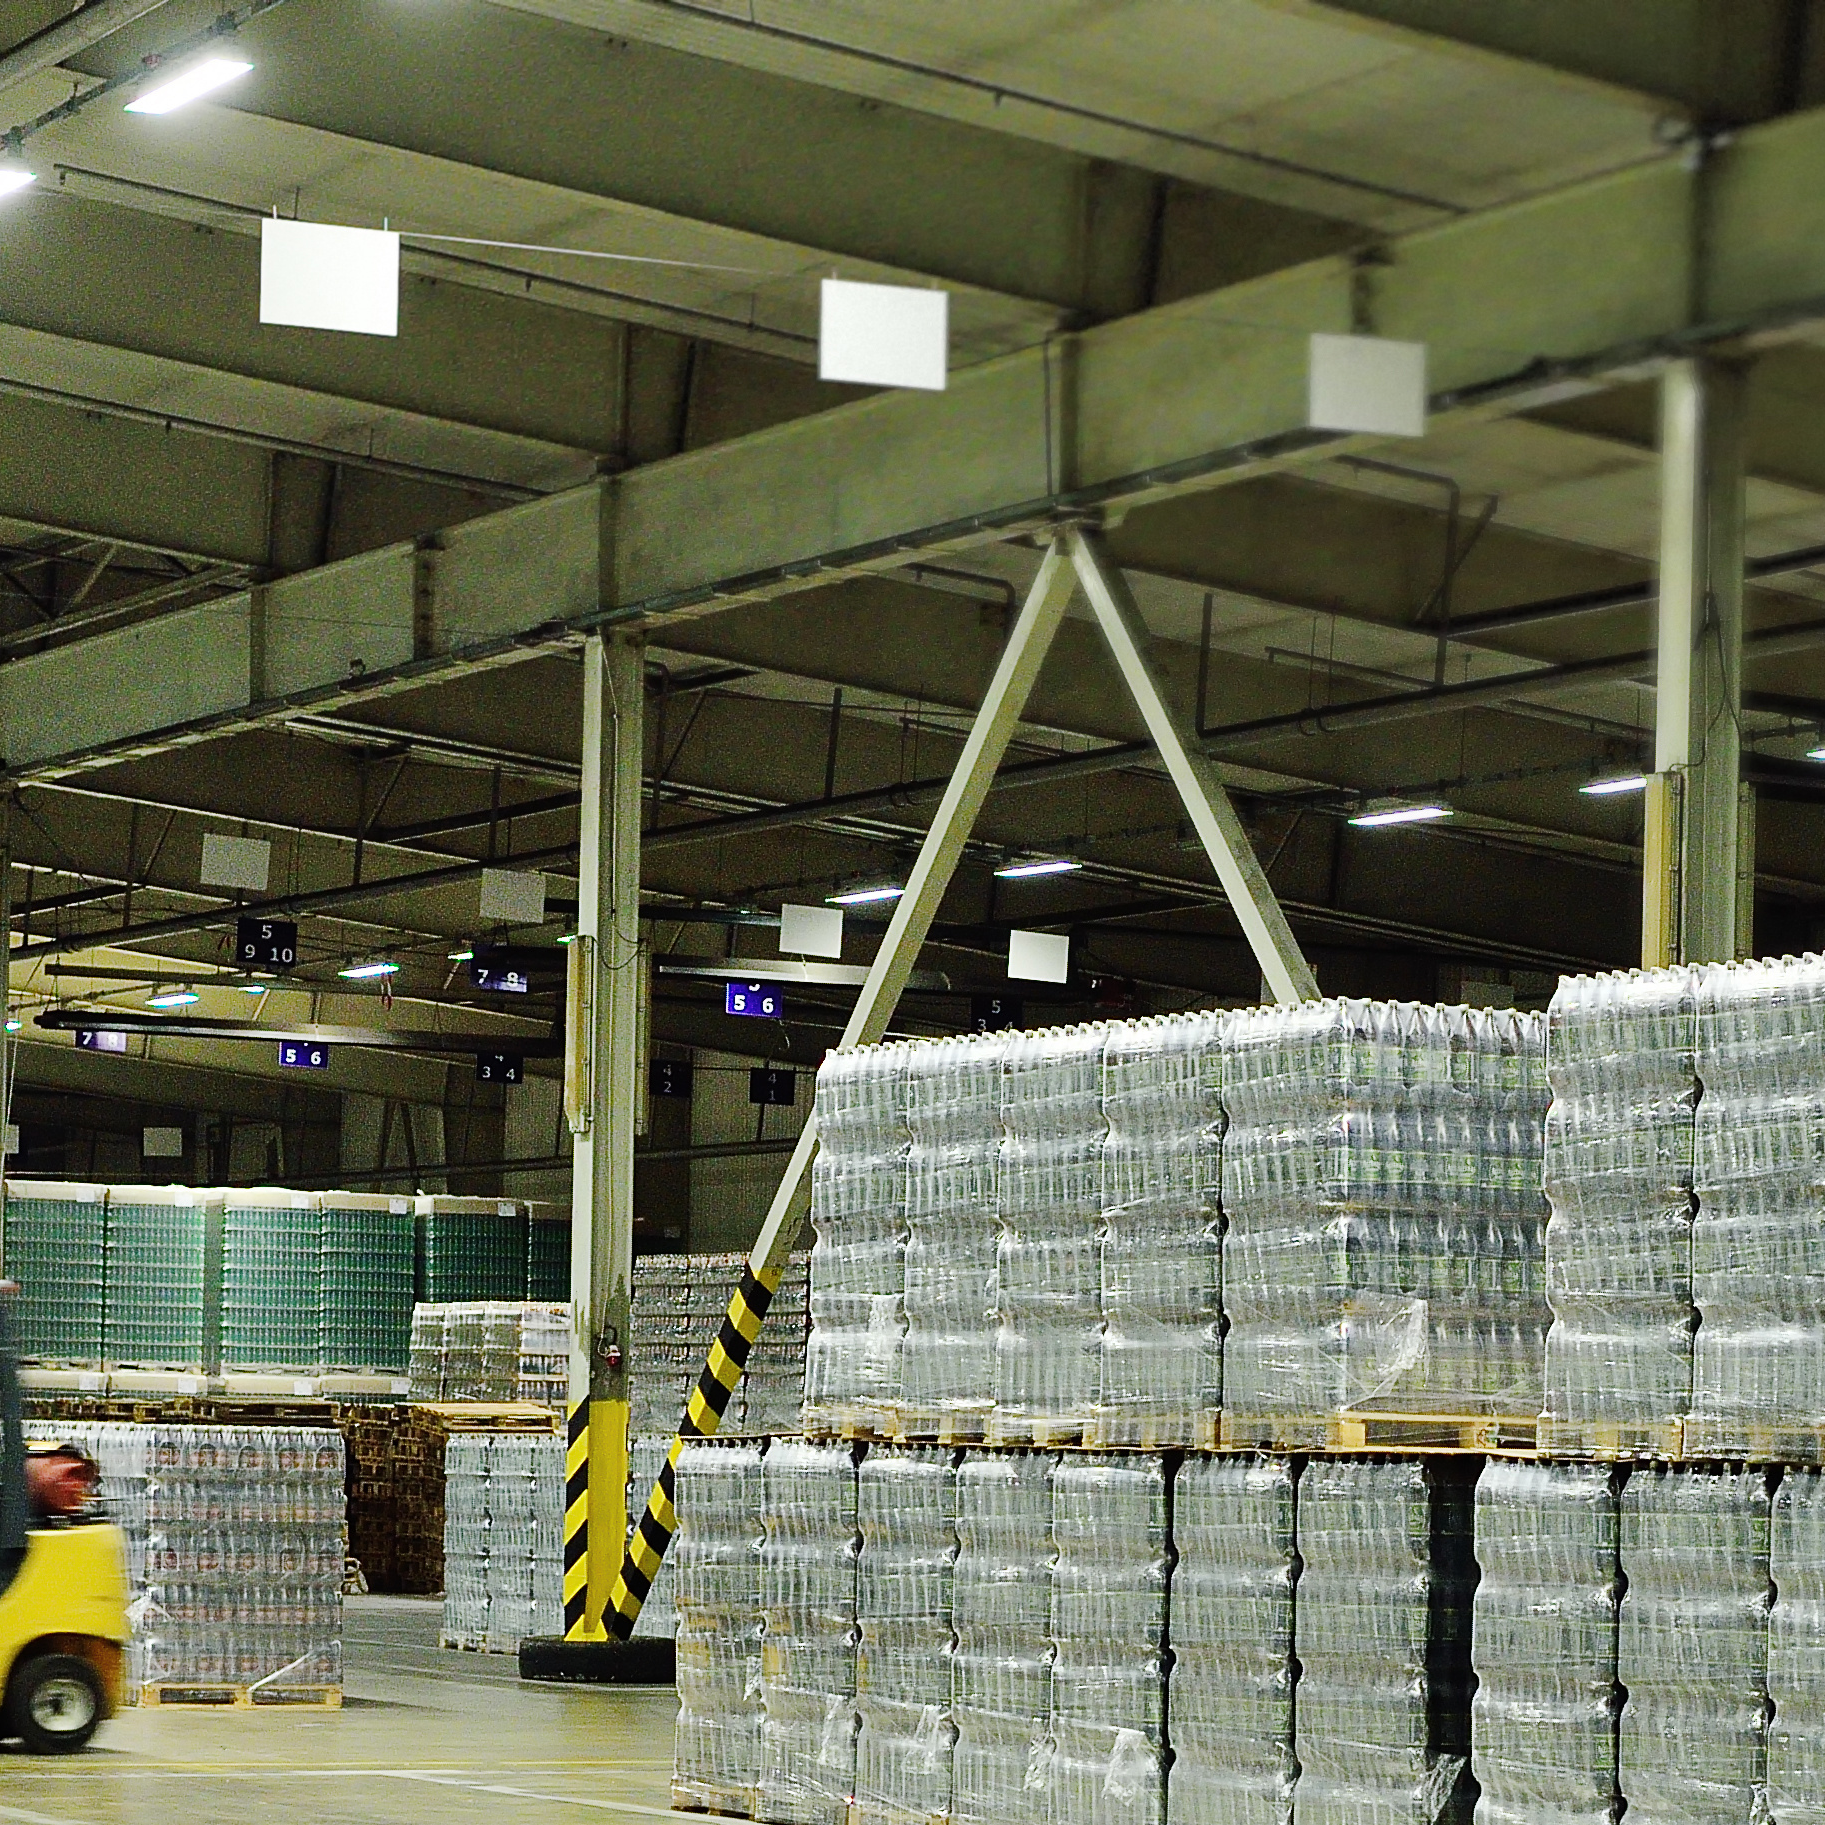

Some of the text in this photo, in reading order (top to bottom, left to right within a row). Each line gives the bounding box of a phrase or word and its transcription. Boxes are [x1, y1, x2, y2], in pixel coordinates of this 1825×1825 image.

[261, 924, 273, 940] 5
[244, 943, 293, 963] 9 10
[477, 968, 520, 988] 7 8
[733, 994, 774, 1014] 5 6
[990, 999, 1002, 1015] 5
[976, 1017, 988, 1033] 3
[82, 1031, 93, 1046] 7
[285, 1048, 322, 1065] 5 6
[482, 1065, 516, 1080] 3 4
[662, 1063, 673, 1077] 4
[767, 1072, 778, 1085] 4
[663, 1081, 673, 1094] 2
